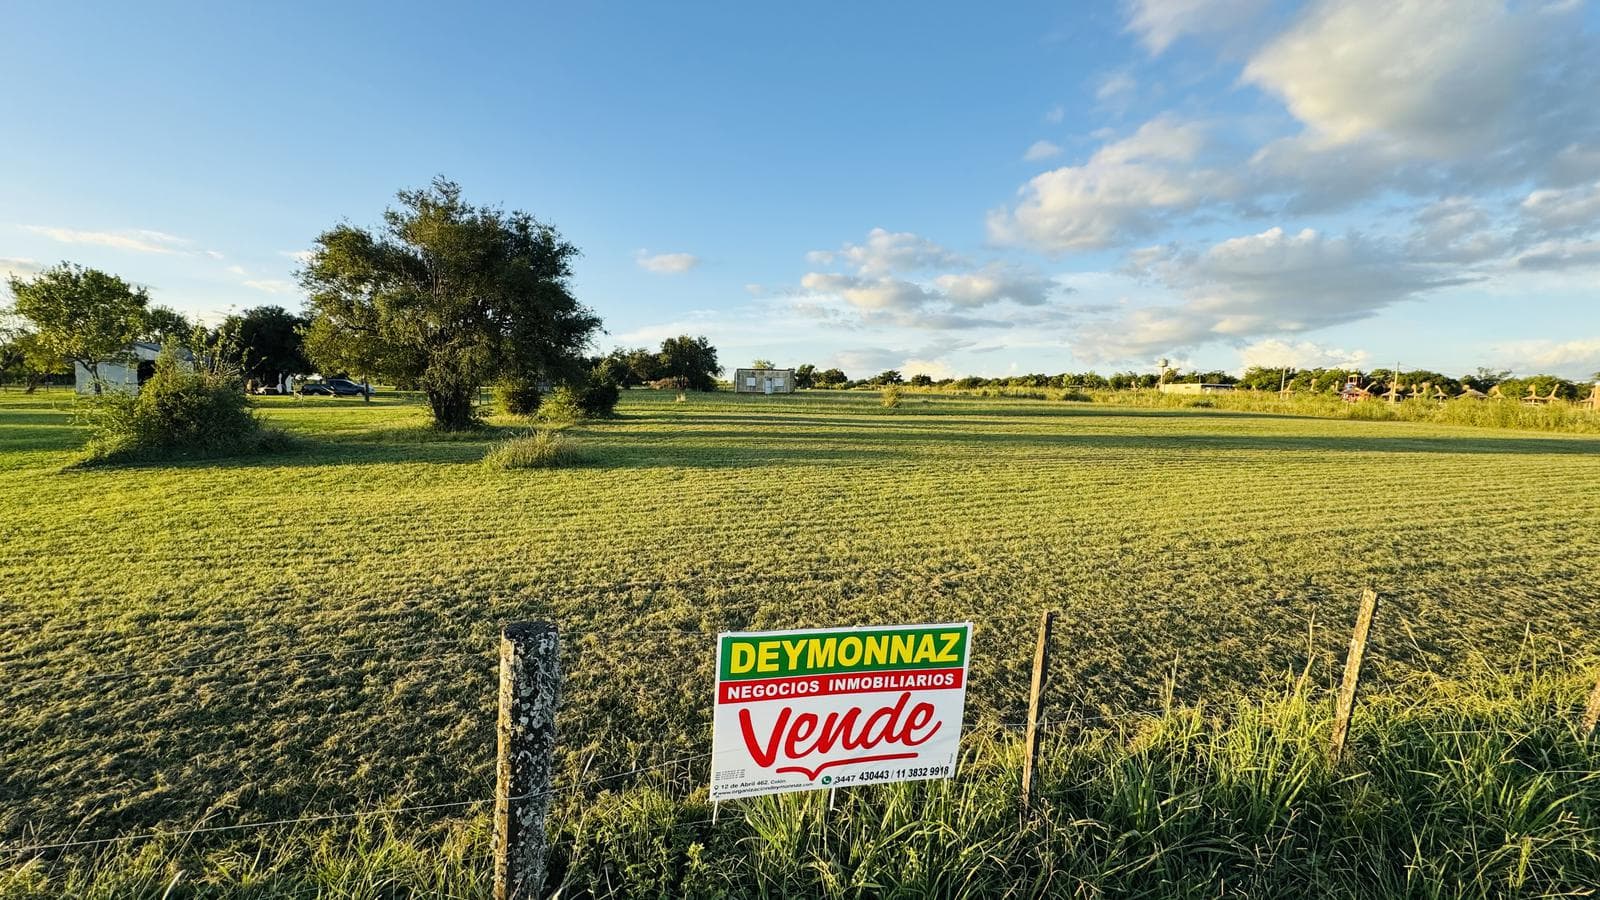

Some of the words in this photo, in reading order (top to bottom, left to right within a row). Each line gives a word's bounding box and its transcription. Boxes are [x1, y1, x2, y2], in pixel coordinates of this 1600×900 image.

[730, 632, 960, 673] DEYMONNAZ
[727, 680, 820, 700] NEGOCIOS
[828, 673, 954, 692] INMOBILIARIOS
[739, 692, 942, 768] Vende
[740, 780, 755, 788] Abril
[835, 775, 856, 784] 3447
[859, 770, 889, 781] 430443
[896, 768, 905, 779] 11
[908, 767, 928, 778] 3832
[929, 765, 949, 776] 9918
